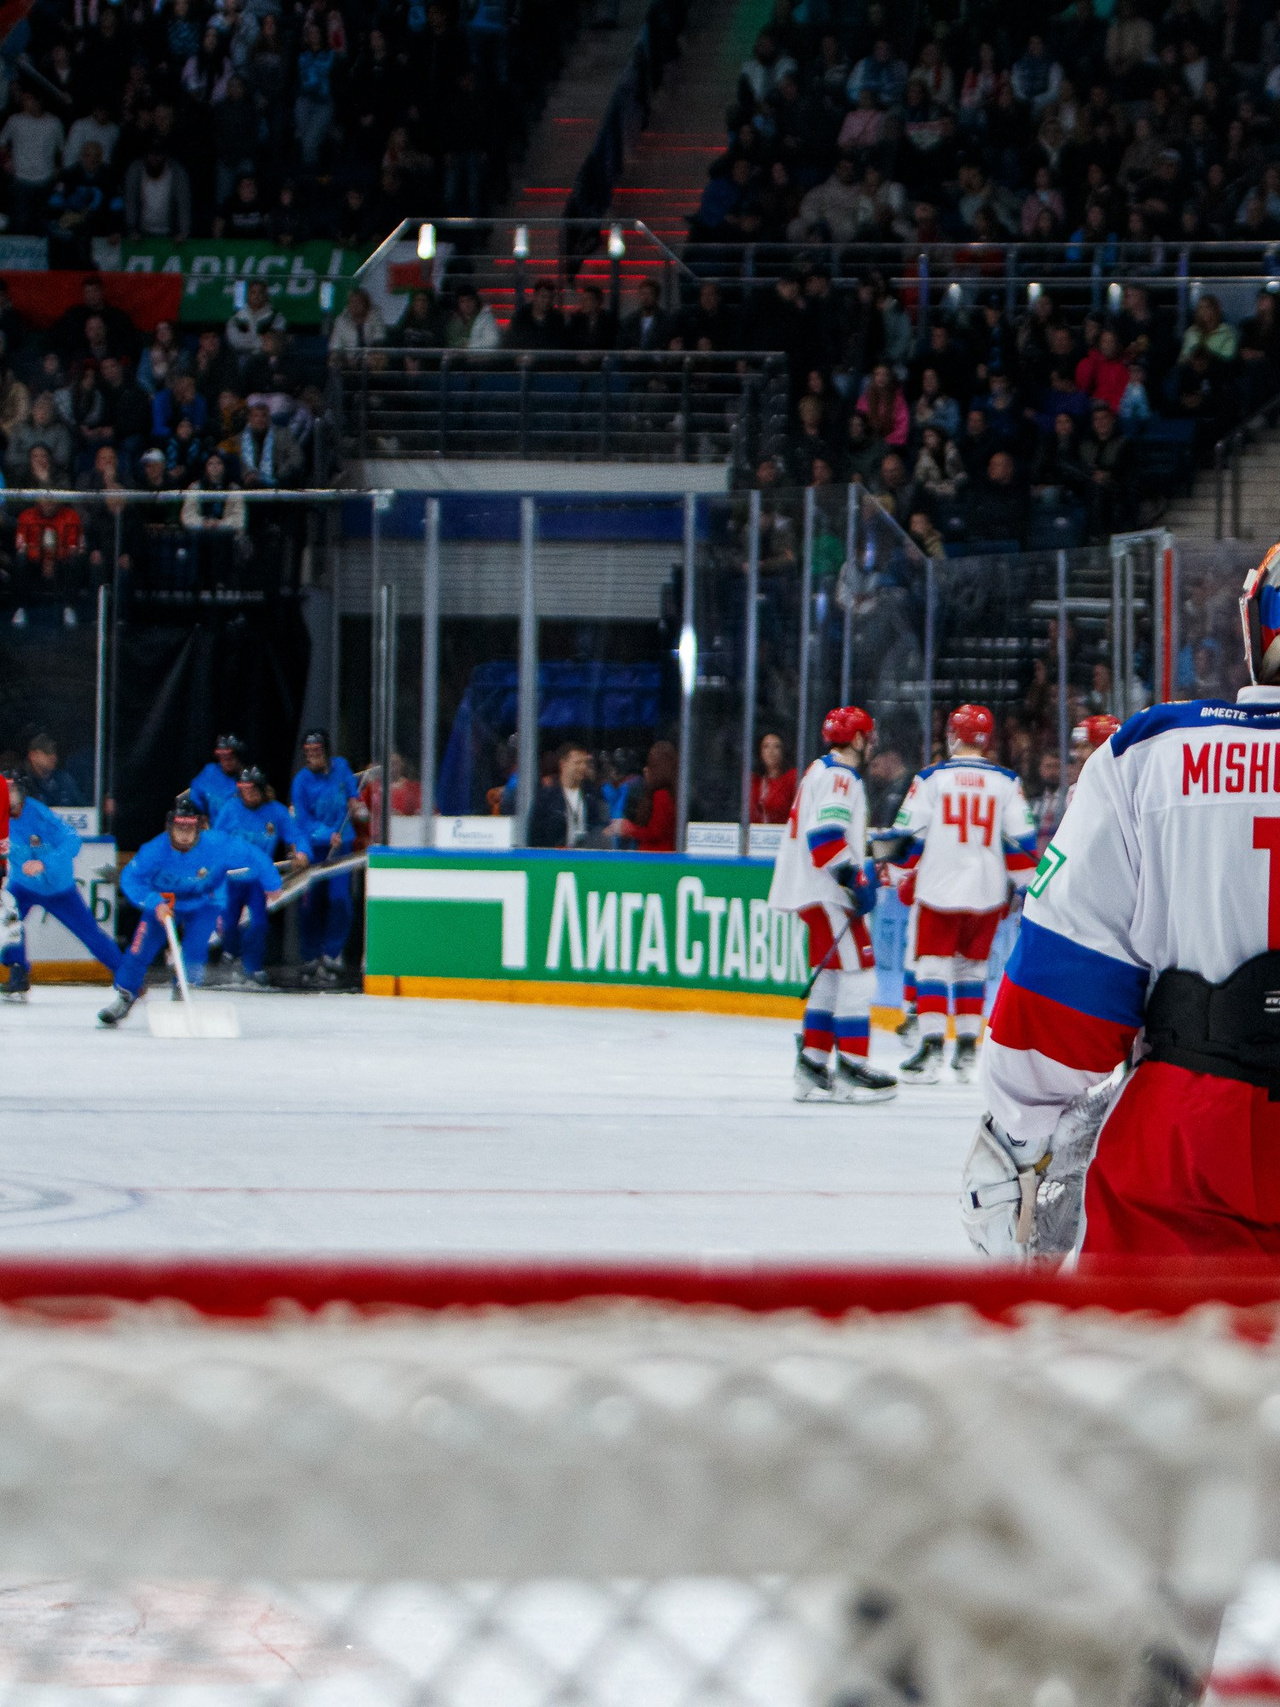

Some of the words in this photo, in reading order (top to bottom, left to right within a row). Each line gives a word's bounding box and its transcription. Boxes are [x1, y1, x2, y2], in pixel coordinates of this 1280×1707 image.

[833, 773, 850, 796] 14
[942, 792, 996, 847] 44
[545, 871, 668, 975] ЛИГА
[675, 876, 809, 984] СТАВОК
